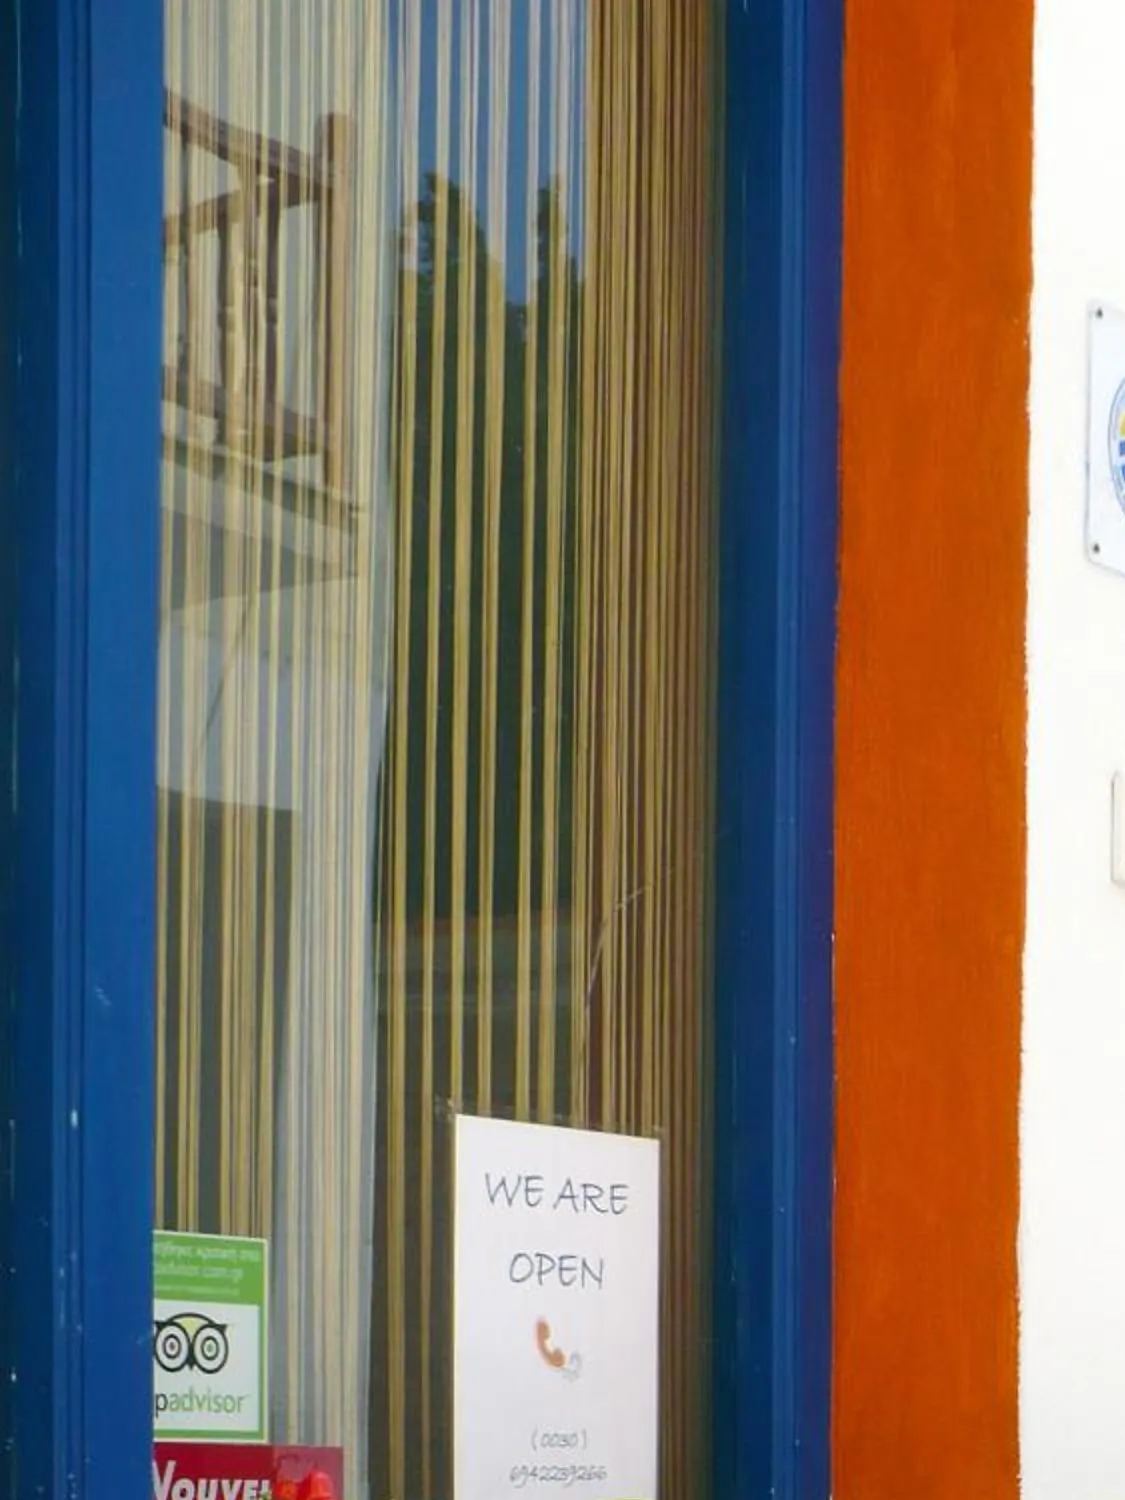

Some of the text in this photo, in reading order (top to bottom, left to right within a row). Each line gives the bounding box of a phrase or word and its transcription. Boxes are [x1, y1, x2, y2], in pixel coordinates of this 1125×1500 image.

[485, 1172, 629, 1215] WE ARE
[508, 1251, 605, 1289] OPEN
